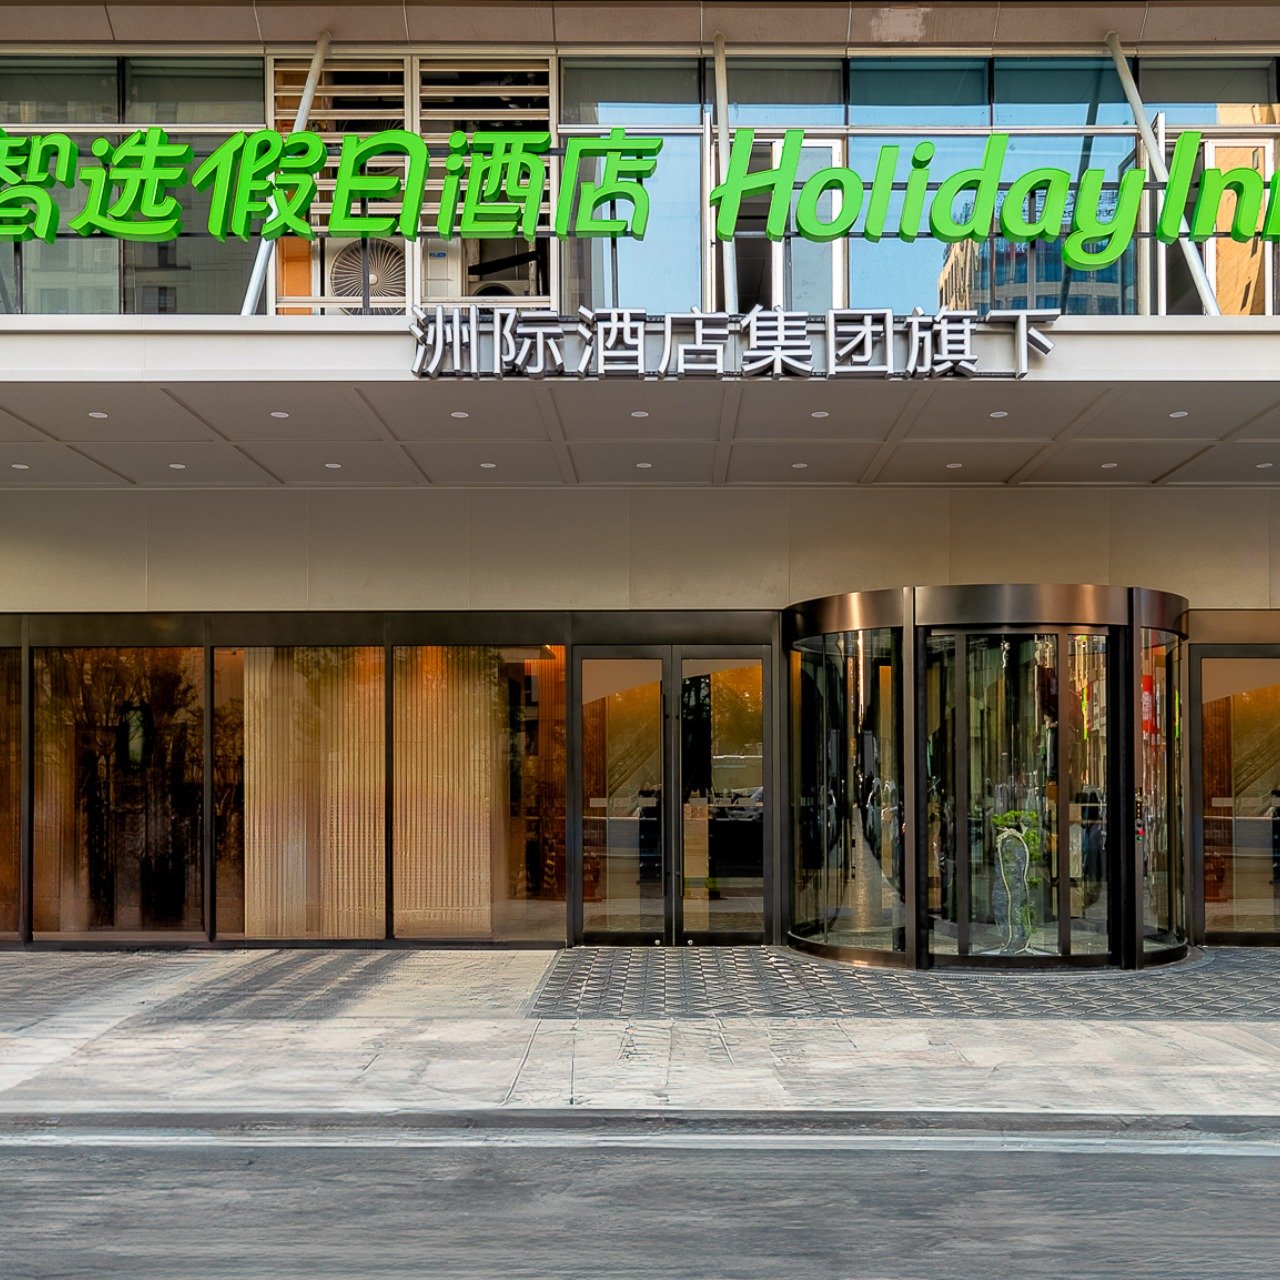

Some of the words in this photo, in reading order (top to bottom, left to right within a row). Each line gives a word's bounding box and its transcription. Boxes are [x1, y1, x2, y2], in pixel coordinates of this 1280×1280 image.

[709, 129, 1146, 272] Holiday
[409, 304, 1062, 381] 洲际酒店集团旗下
